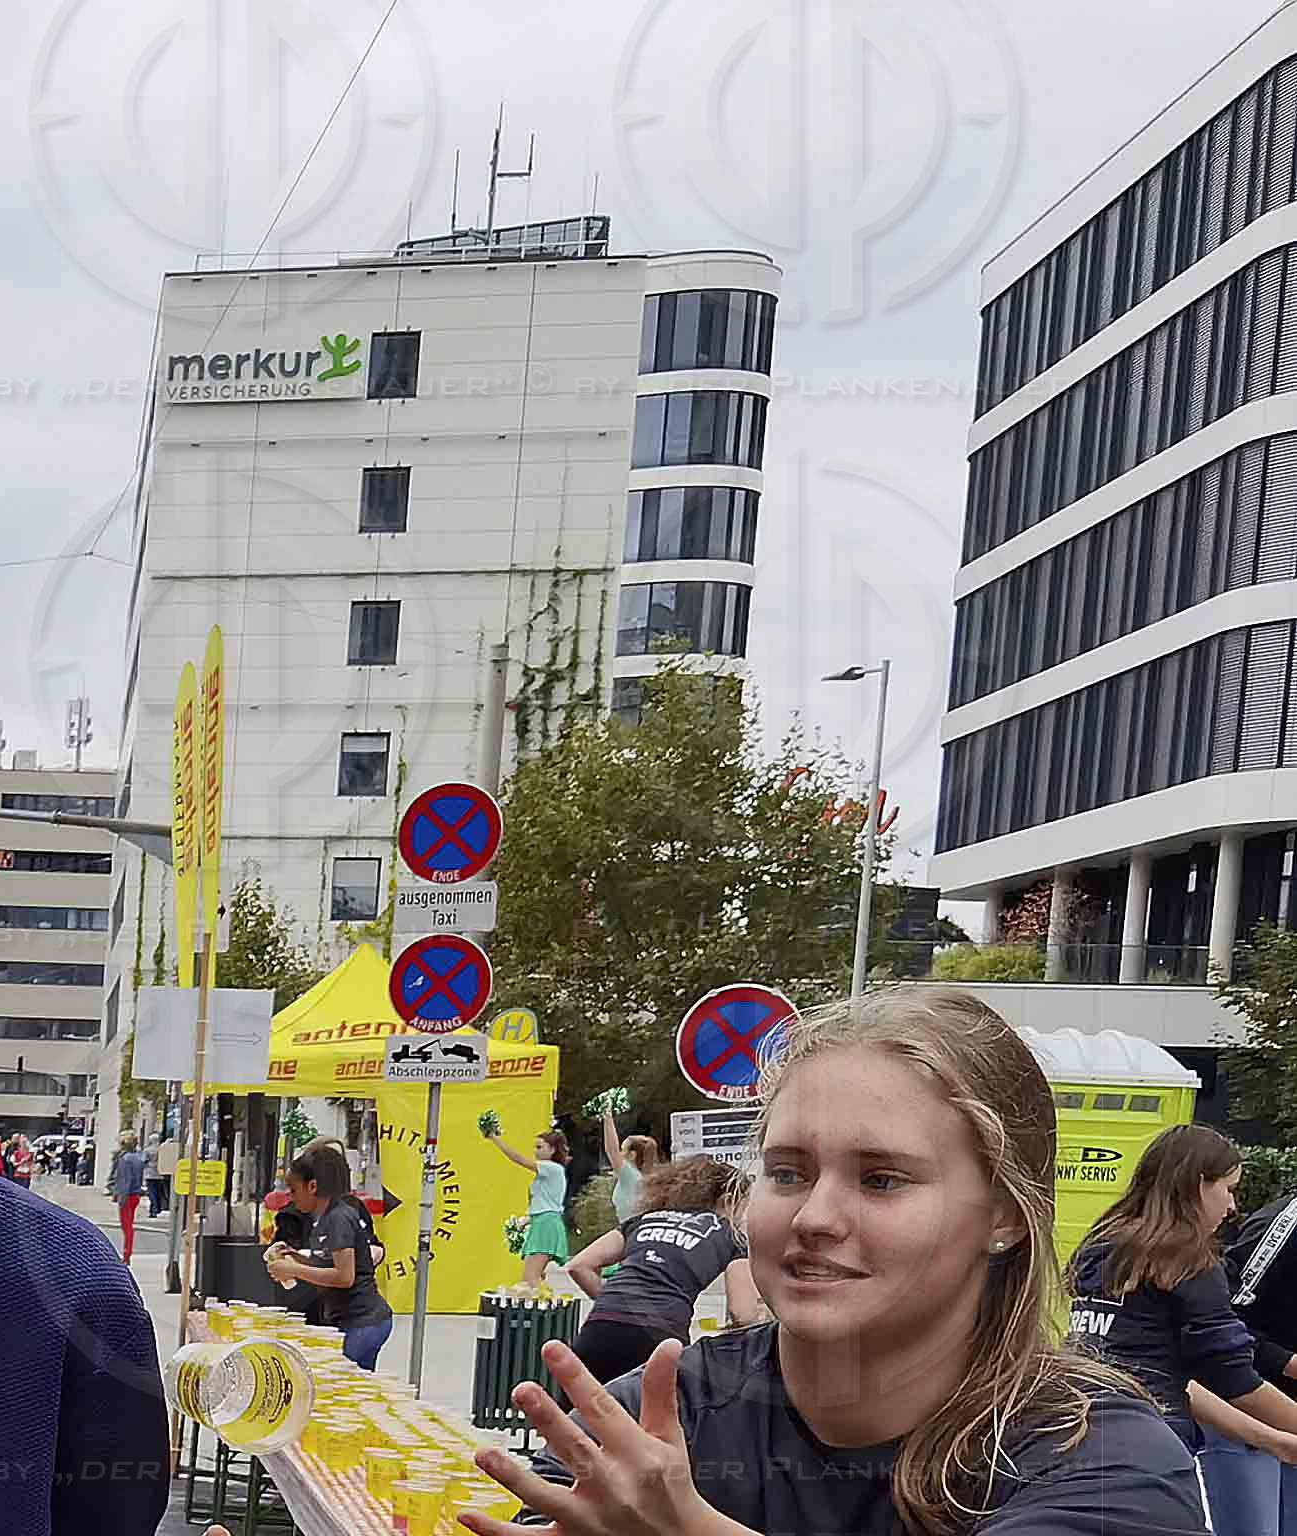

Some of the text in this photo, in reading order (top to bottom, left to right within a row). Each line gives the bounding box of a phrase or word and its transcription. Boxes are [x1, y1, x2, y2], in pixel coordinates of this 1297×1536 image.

[168, 349, 322, 381] merkur
[166, 383, 312, 400] VERSICHERUNG
[431, 869, 461, 882] ENDE
[398, 889, 492, 913] ausgenommen
[431, 909, 457, 926] Taxi
[409, 1016, 463, 1032] ANFANG
[489, 1054, 548, 1074] enne
[389, 1066, 480, 1082] Abschleppzone
[1056, 1165, 1118, 1182] NNY SERVIS
[636, 1227, 703, 1250] CREW
